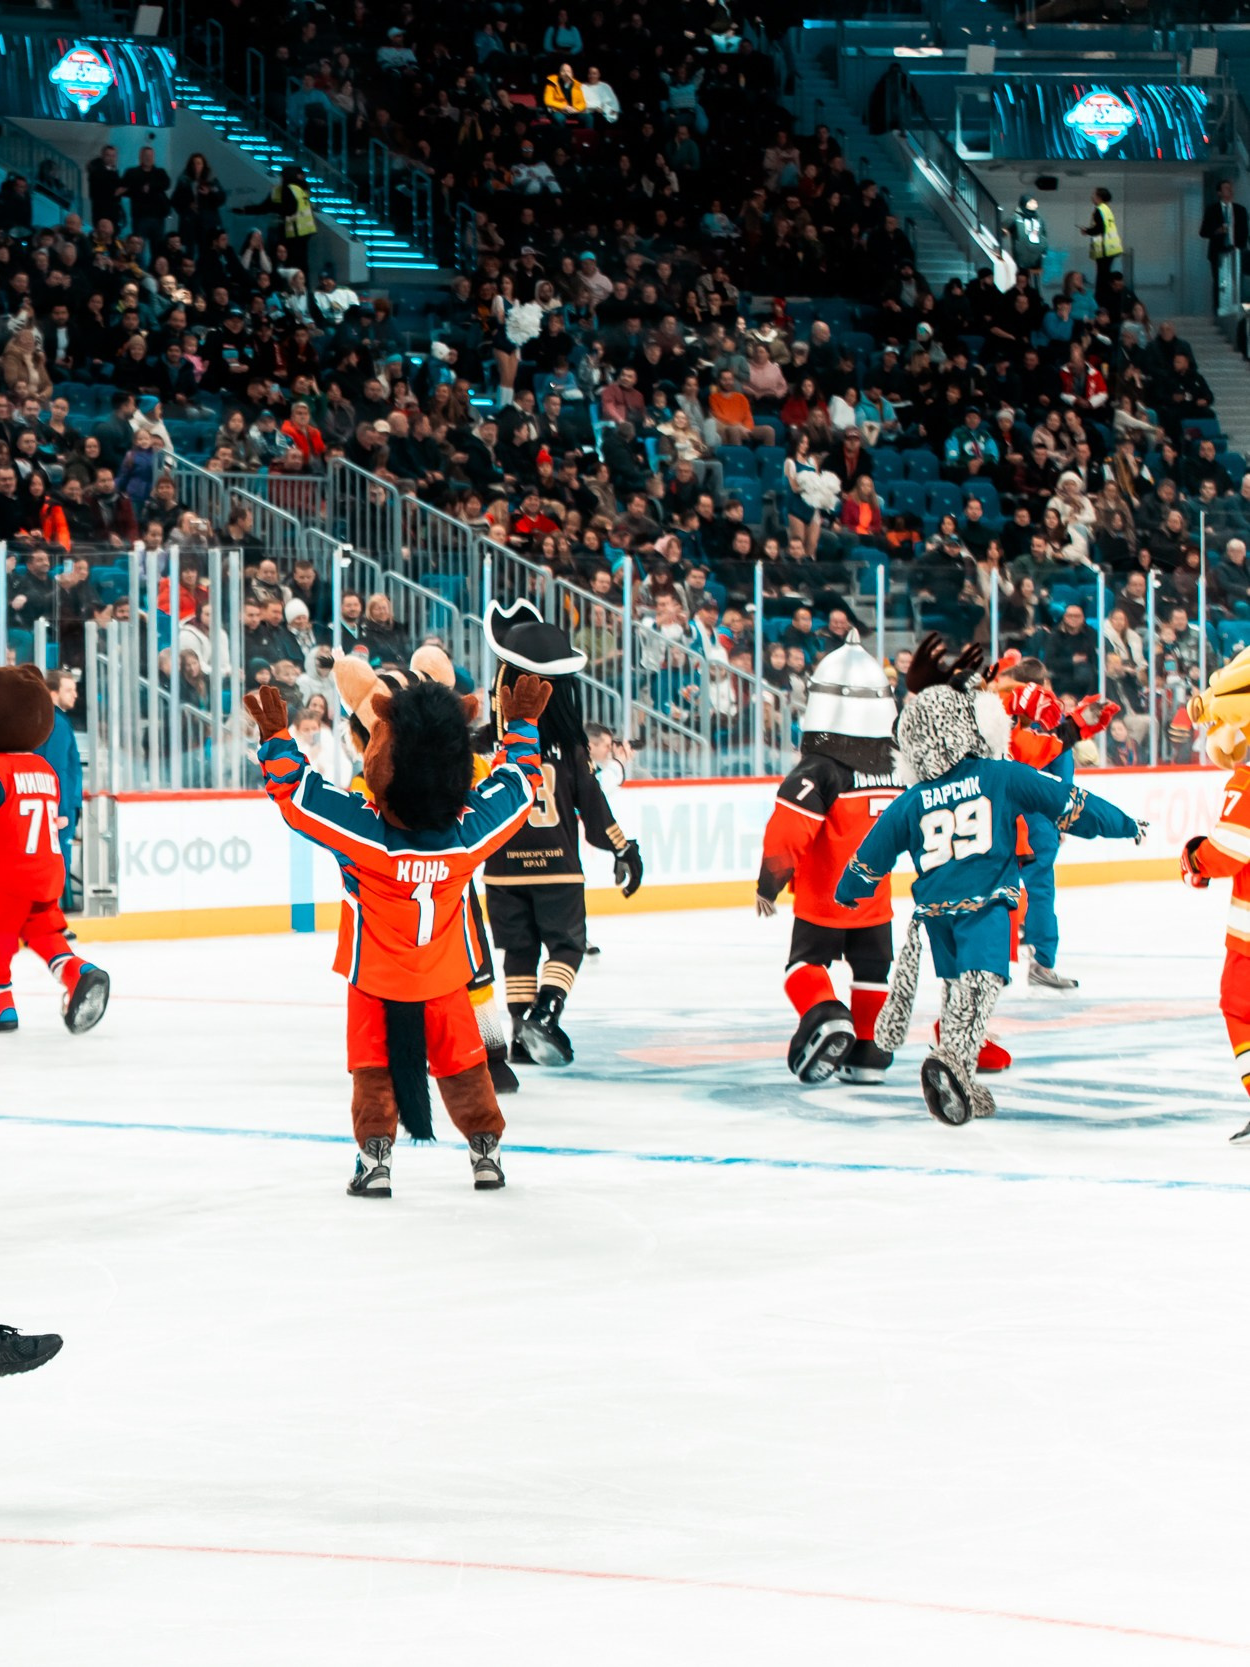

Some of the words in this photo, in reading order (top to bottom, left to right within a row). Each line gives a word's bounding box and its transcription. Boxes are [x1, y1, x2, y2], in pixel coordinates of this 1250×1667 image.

[796, 778, 815, 800] 7
[919, 776, 982, 810] БАРСИК
[918, 795, 993, 874] 99
[124, 835, 252, 877] КОФФ
[506, 847, 564, 859] ПРИМОРСКИЙ
[523, 858, 548, 868] КРАЙ
[396, 860, 450, 883] КОНЬ
[410, 882, 436, 947] 1
